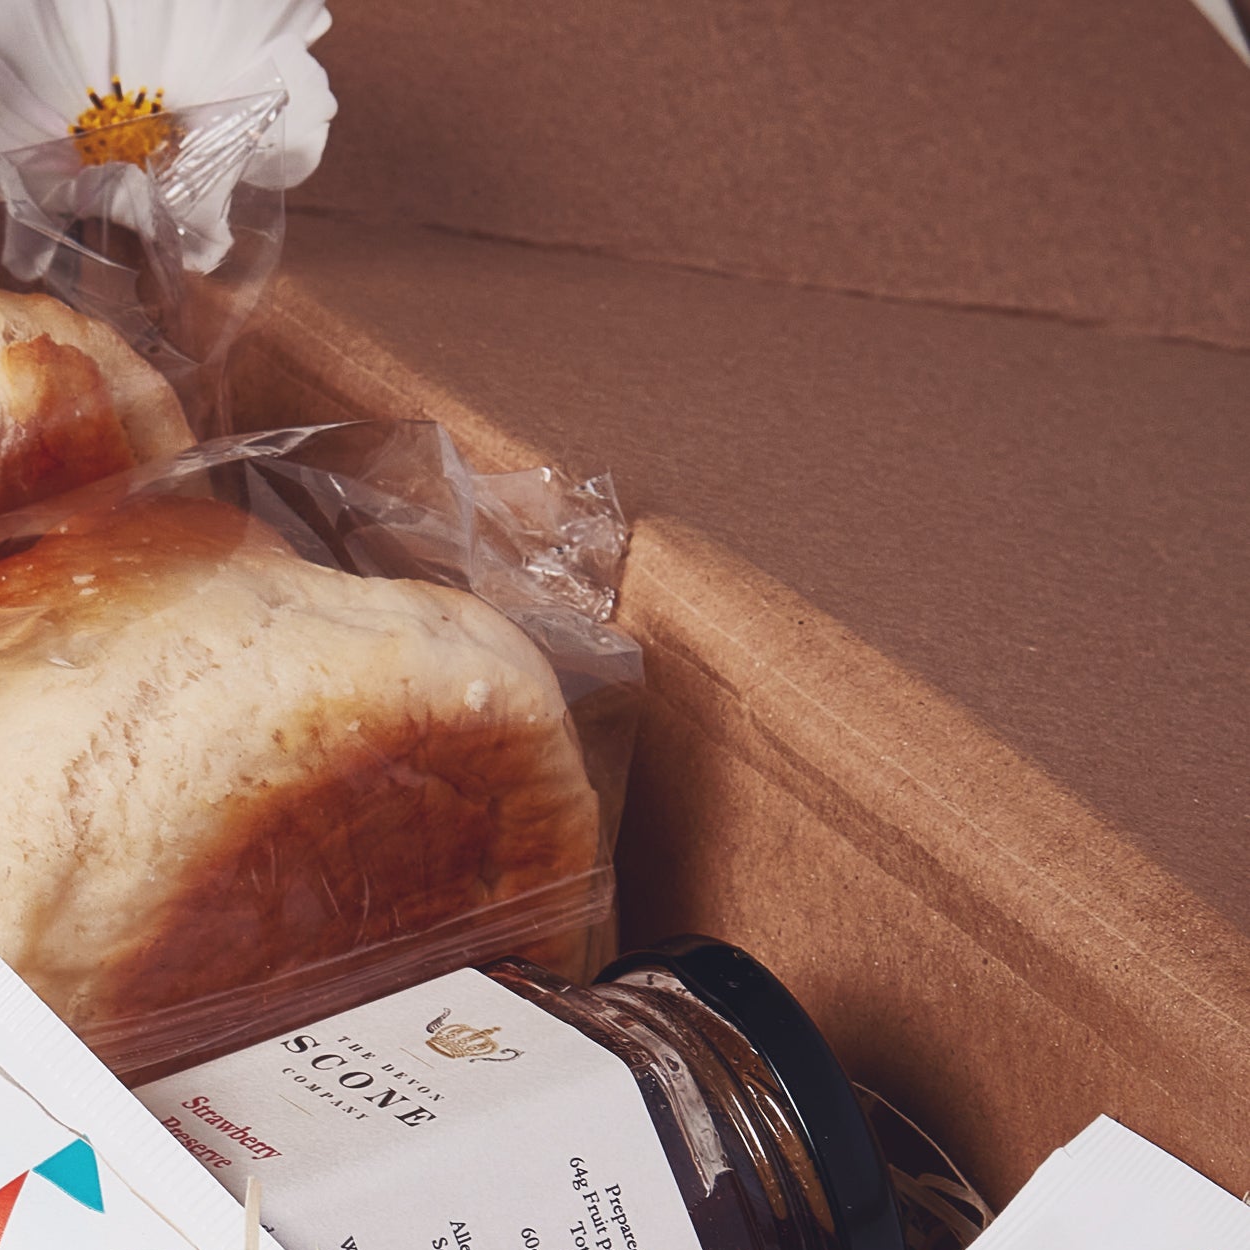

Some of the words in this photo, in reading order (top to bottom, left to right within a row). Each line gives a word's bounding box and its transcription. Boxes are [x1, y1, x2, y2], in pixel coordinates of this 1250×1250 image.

[280, 1035, 437, 1127] SCONE
[281, 1067, 372, 1121] COMPANY
[337, 1036, 377, 1060] THE
[380, 1062, 446, 1102] DEVON
[181, 1095, 283, 1160] Strawberry
[569, 1156, 589, 1191] 64g
[582, 1190, 609, 1234] Fruit
